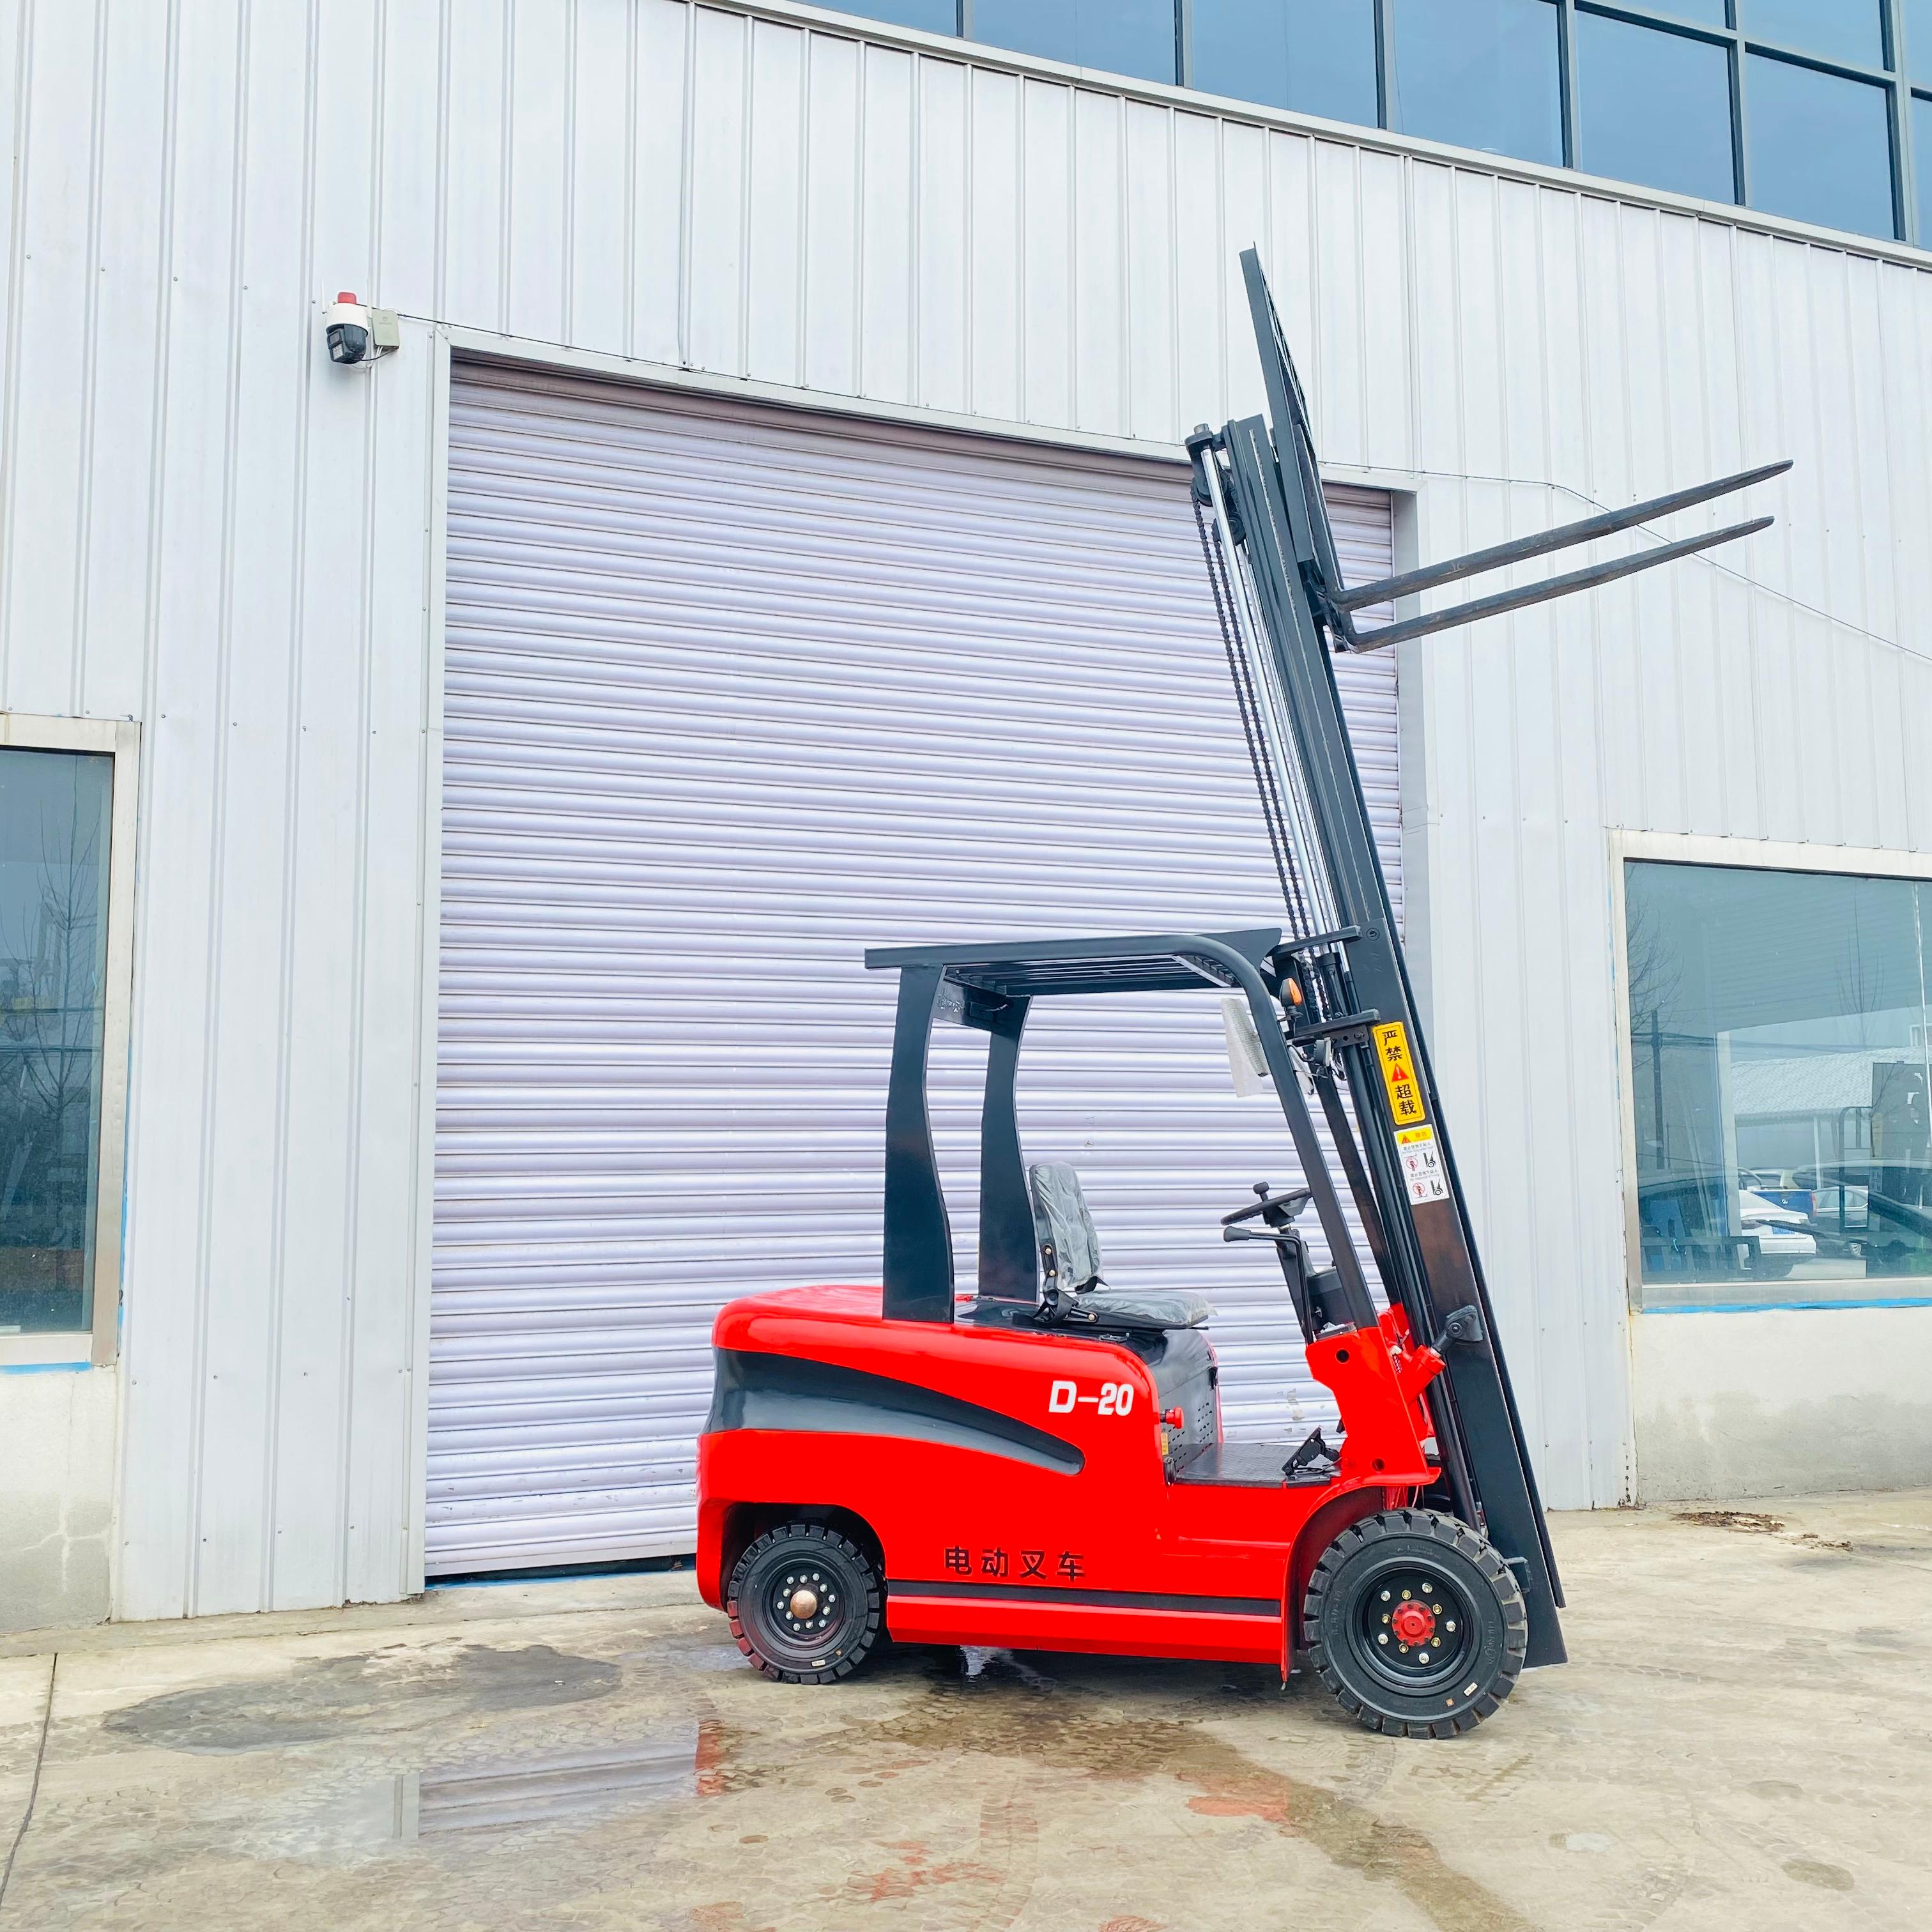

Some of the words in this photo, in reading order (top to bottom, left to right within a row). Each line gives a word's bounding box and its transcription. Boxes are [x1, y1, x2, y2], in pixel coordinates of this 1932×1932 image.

[1381, 1029, 1402, 1062] 严禁
[1395, 1084, 1417, 1116] 超载
[1048, 1380, 1134, 1416] D-20
[944, 1545, 1086, 1581] 电动叉车
